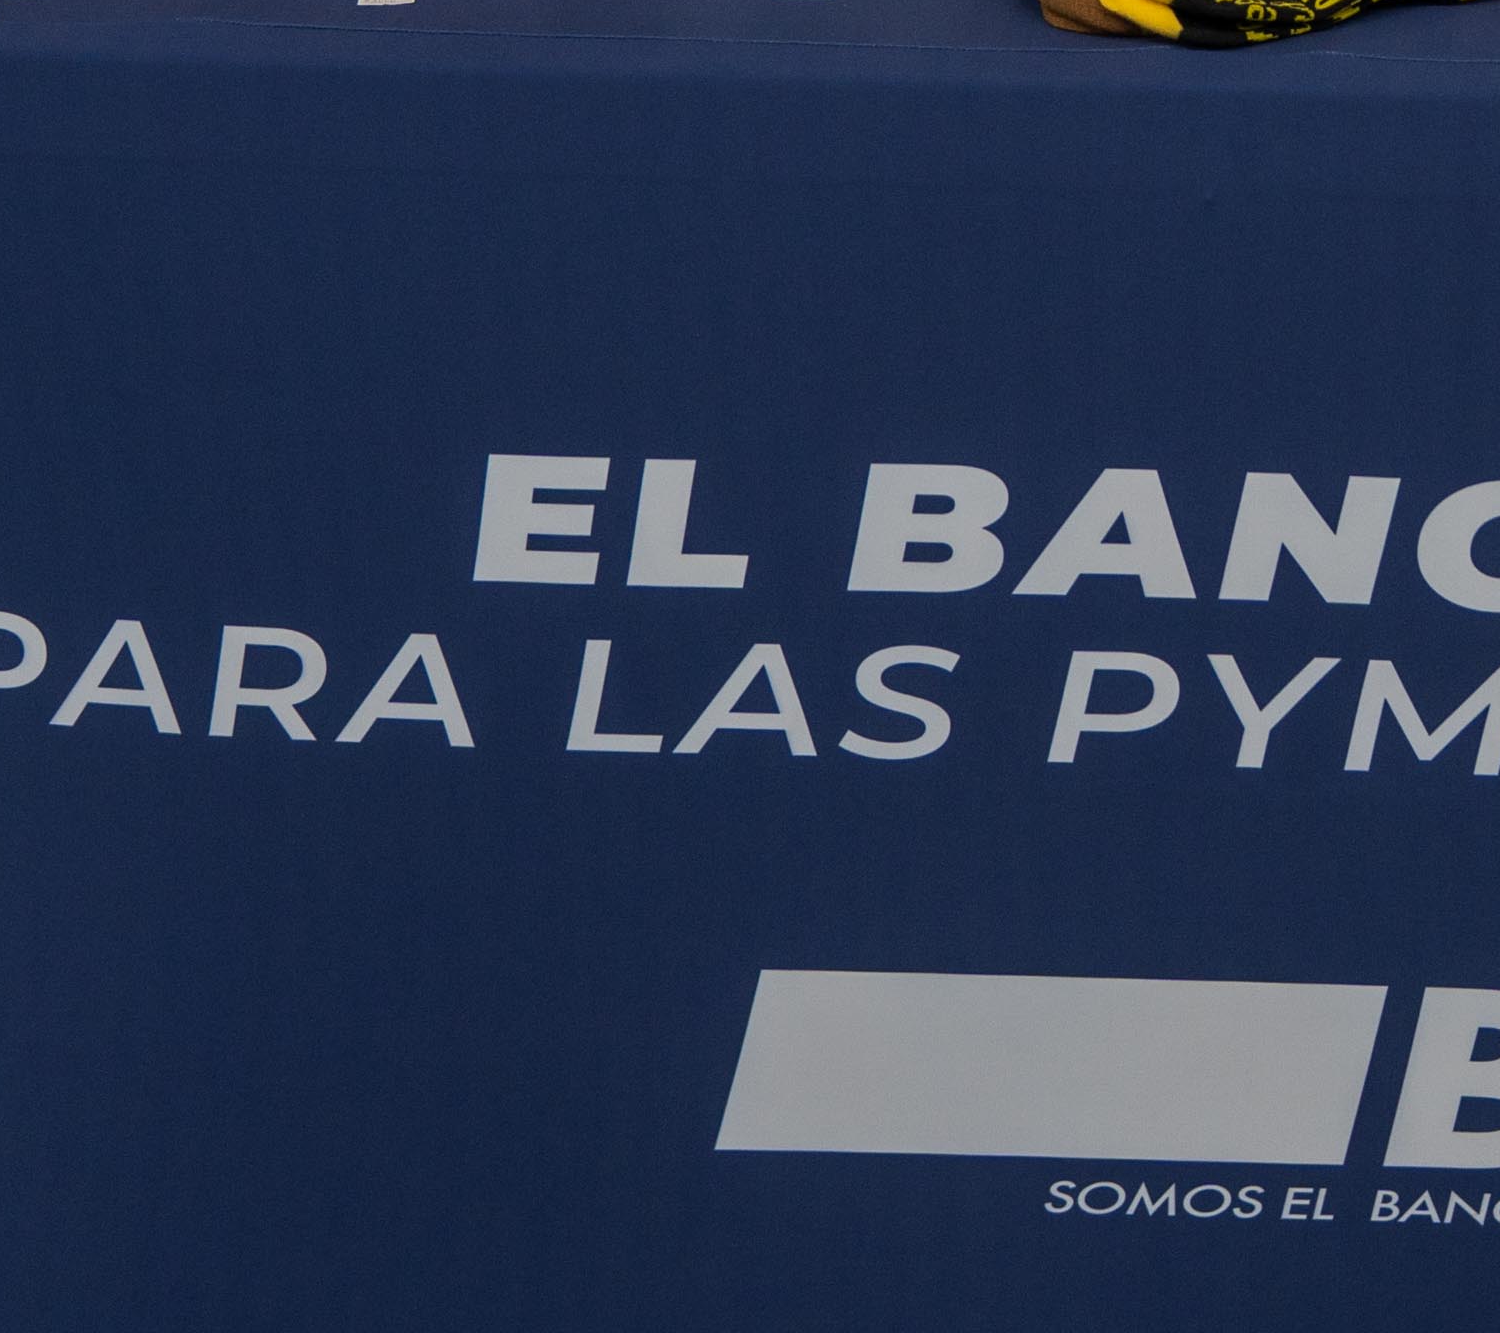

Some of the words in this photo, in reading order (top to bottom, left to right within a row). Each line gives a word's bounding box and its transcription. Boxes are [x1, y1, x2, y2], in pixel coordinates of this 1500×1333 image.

[472, 453, 750, 589] EL
[564, 638, 962, 760] LAS
[1043, 1179, 1267, 1221] SOMOS
[1279, 1188, 1336, 1223] EL
